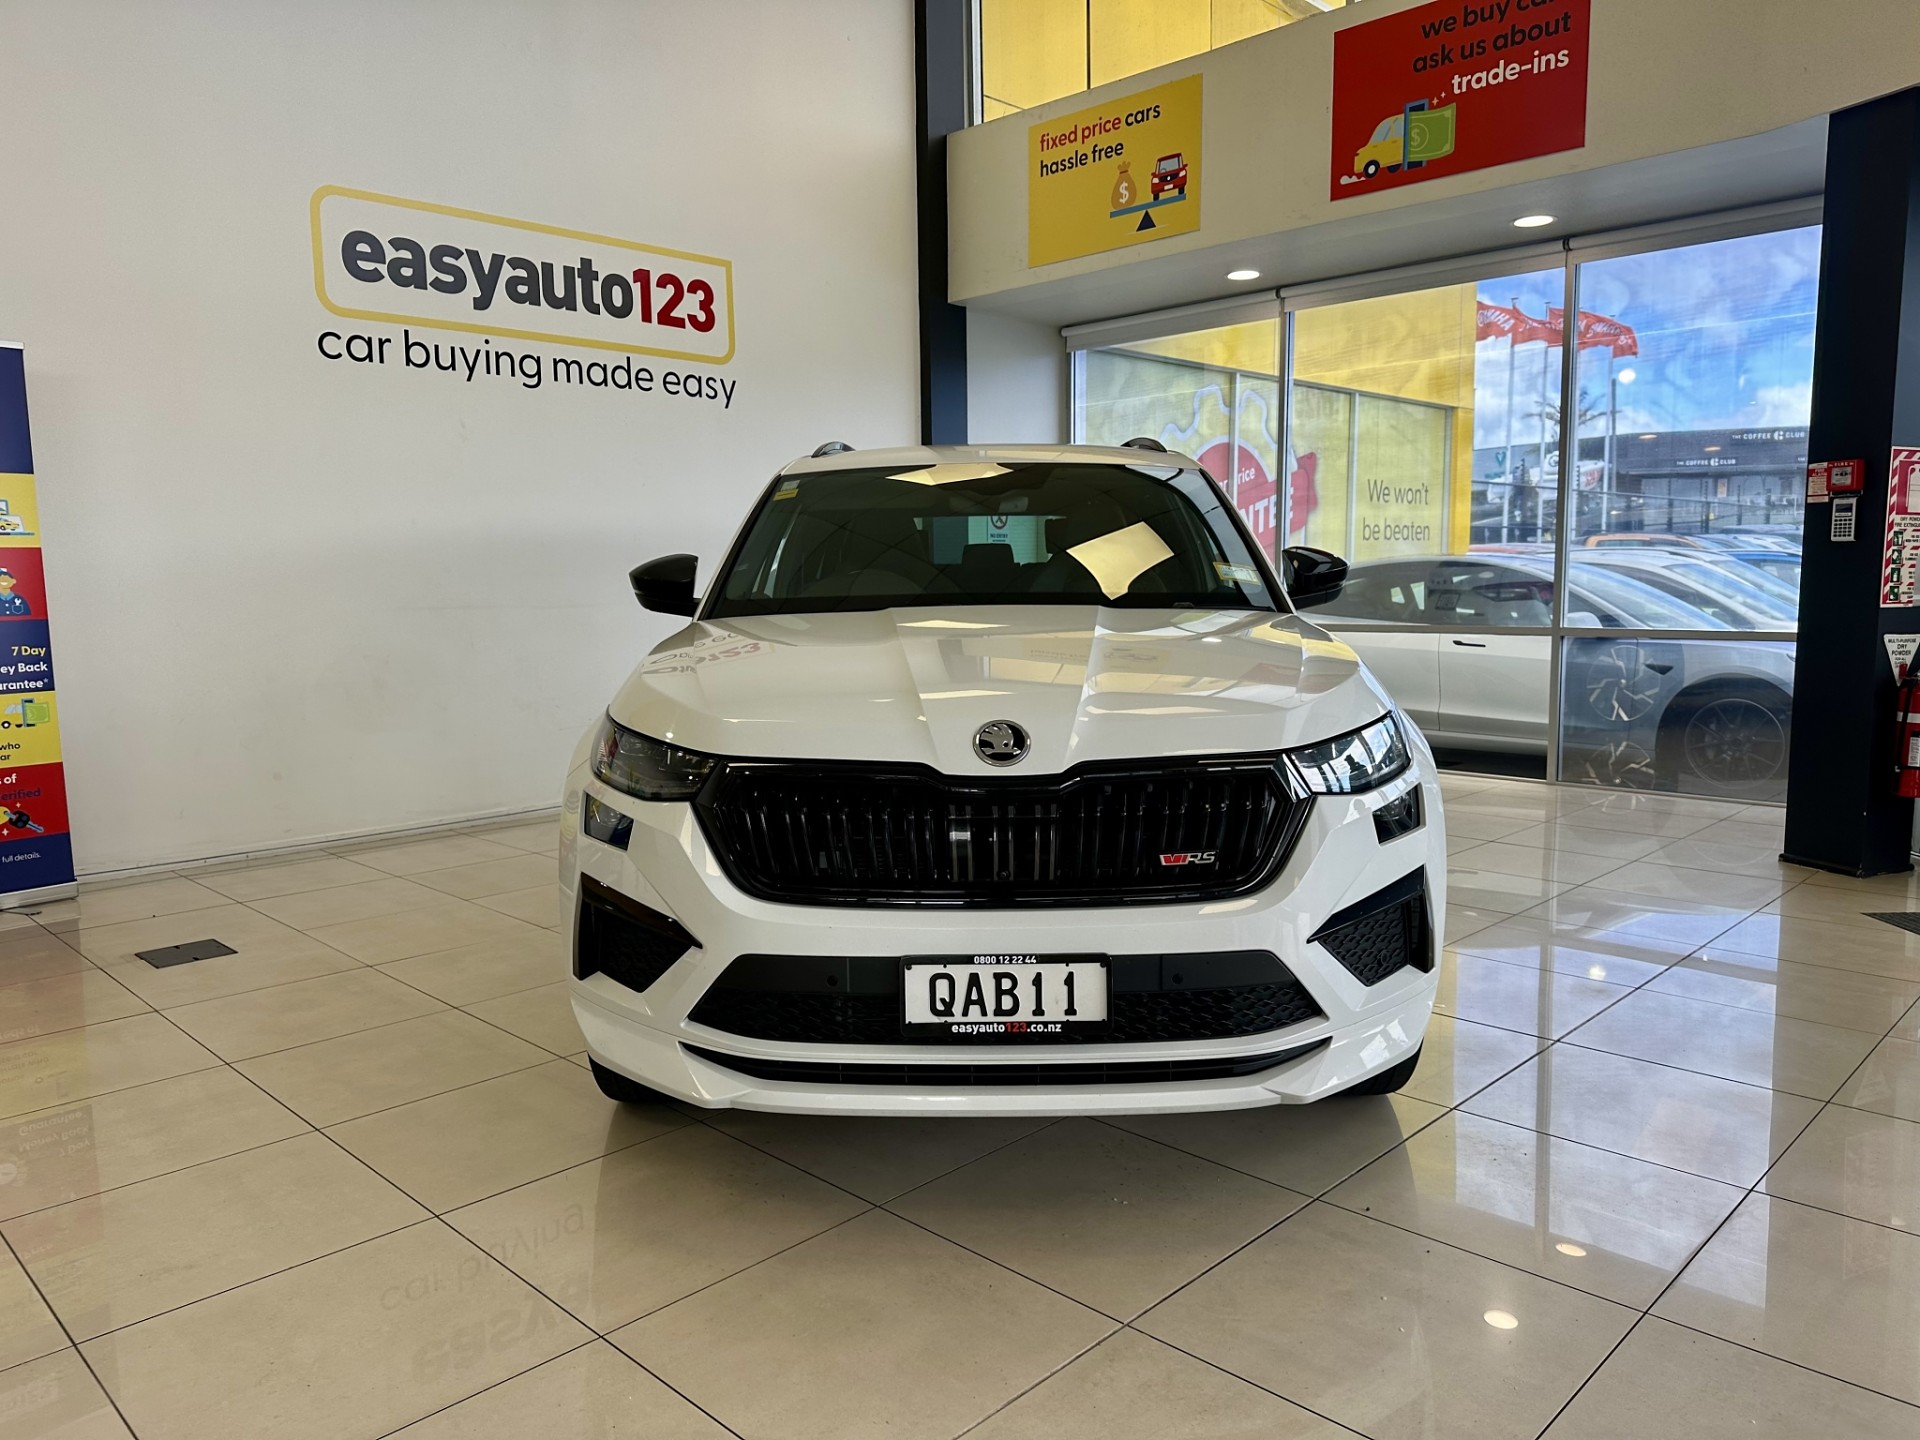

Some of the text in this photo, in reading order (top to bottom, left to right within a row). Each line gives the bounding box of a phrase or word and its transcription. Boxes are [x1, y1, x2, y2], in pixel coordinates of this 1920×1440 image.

[1421, 15, 1457, 39] we
[1463, 0, 1510, 27] buy
[1412, 11, 1572, 73] ask us about
[1452, 49, 1569, 95] trade-ins
[1040, 104, 1161, 152] fixed price cars
[1040, 142, 1124, 177] hassle free
[341, 230, 716, 333] easyauto123
[317, 328, 737, 409] car buying made easy
[1743, 432, 1771, 440] COFFEE
[1785, 431, 1805, 439] CLUB
[1237, 466, 1256, 485] rice
[1367, 478, 1429, 506] We won't
[1363, 517, 1430, 541] be beaten
[11, 646, 46, 657] 7 Day
[18, 661, 48, 672] Back
[3, 772, 17, 784] of
[2, 855, 13, 863] full
[974, 956, 1037, 964] 0800 12 22 44
[929, 971, 1077, 1017] QAB11
[951, 1023, 1062, 1035] easyauto123.co.nz
